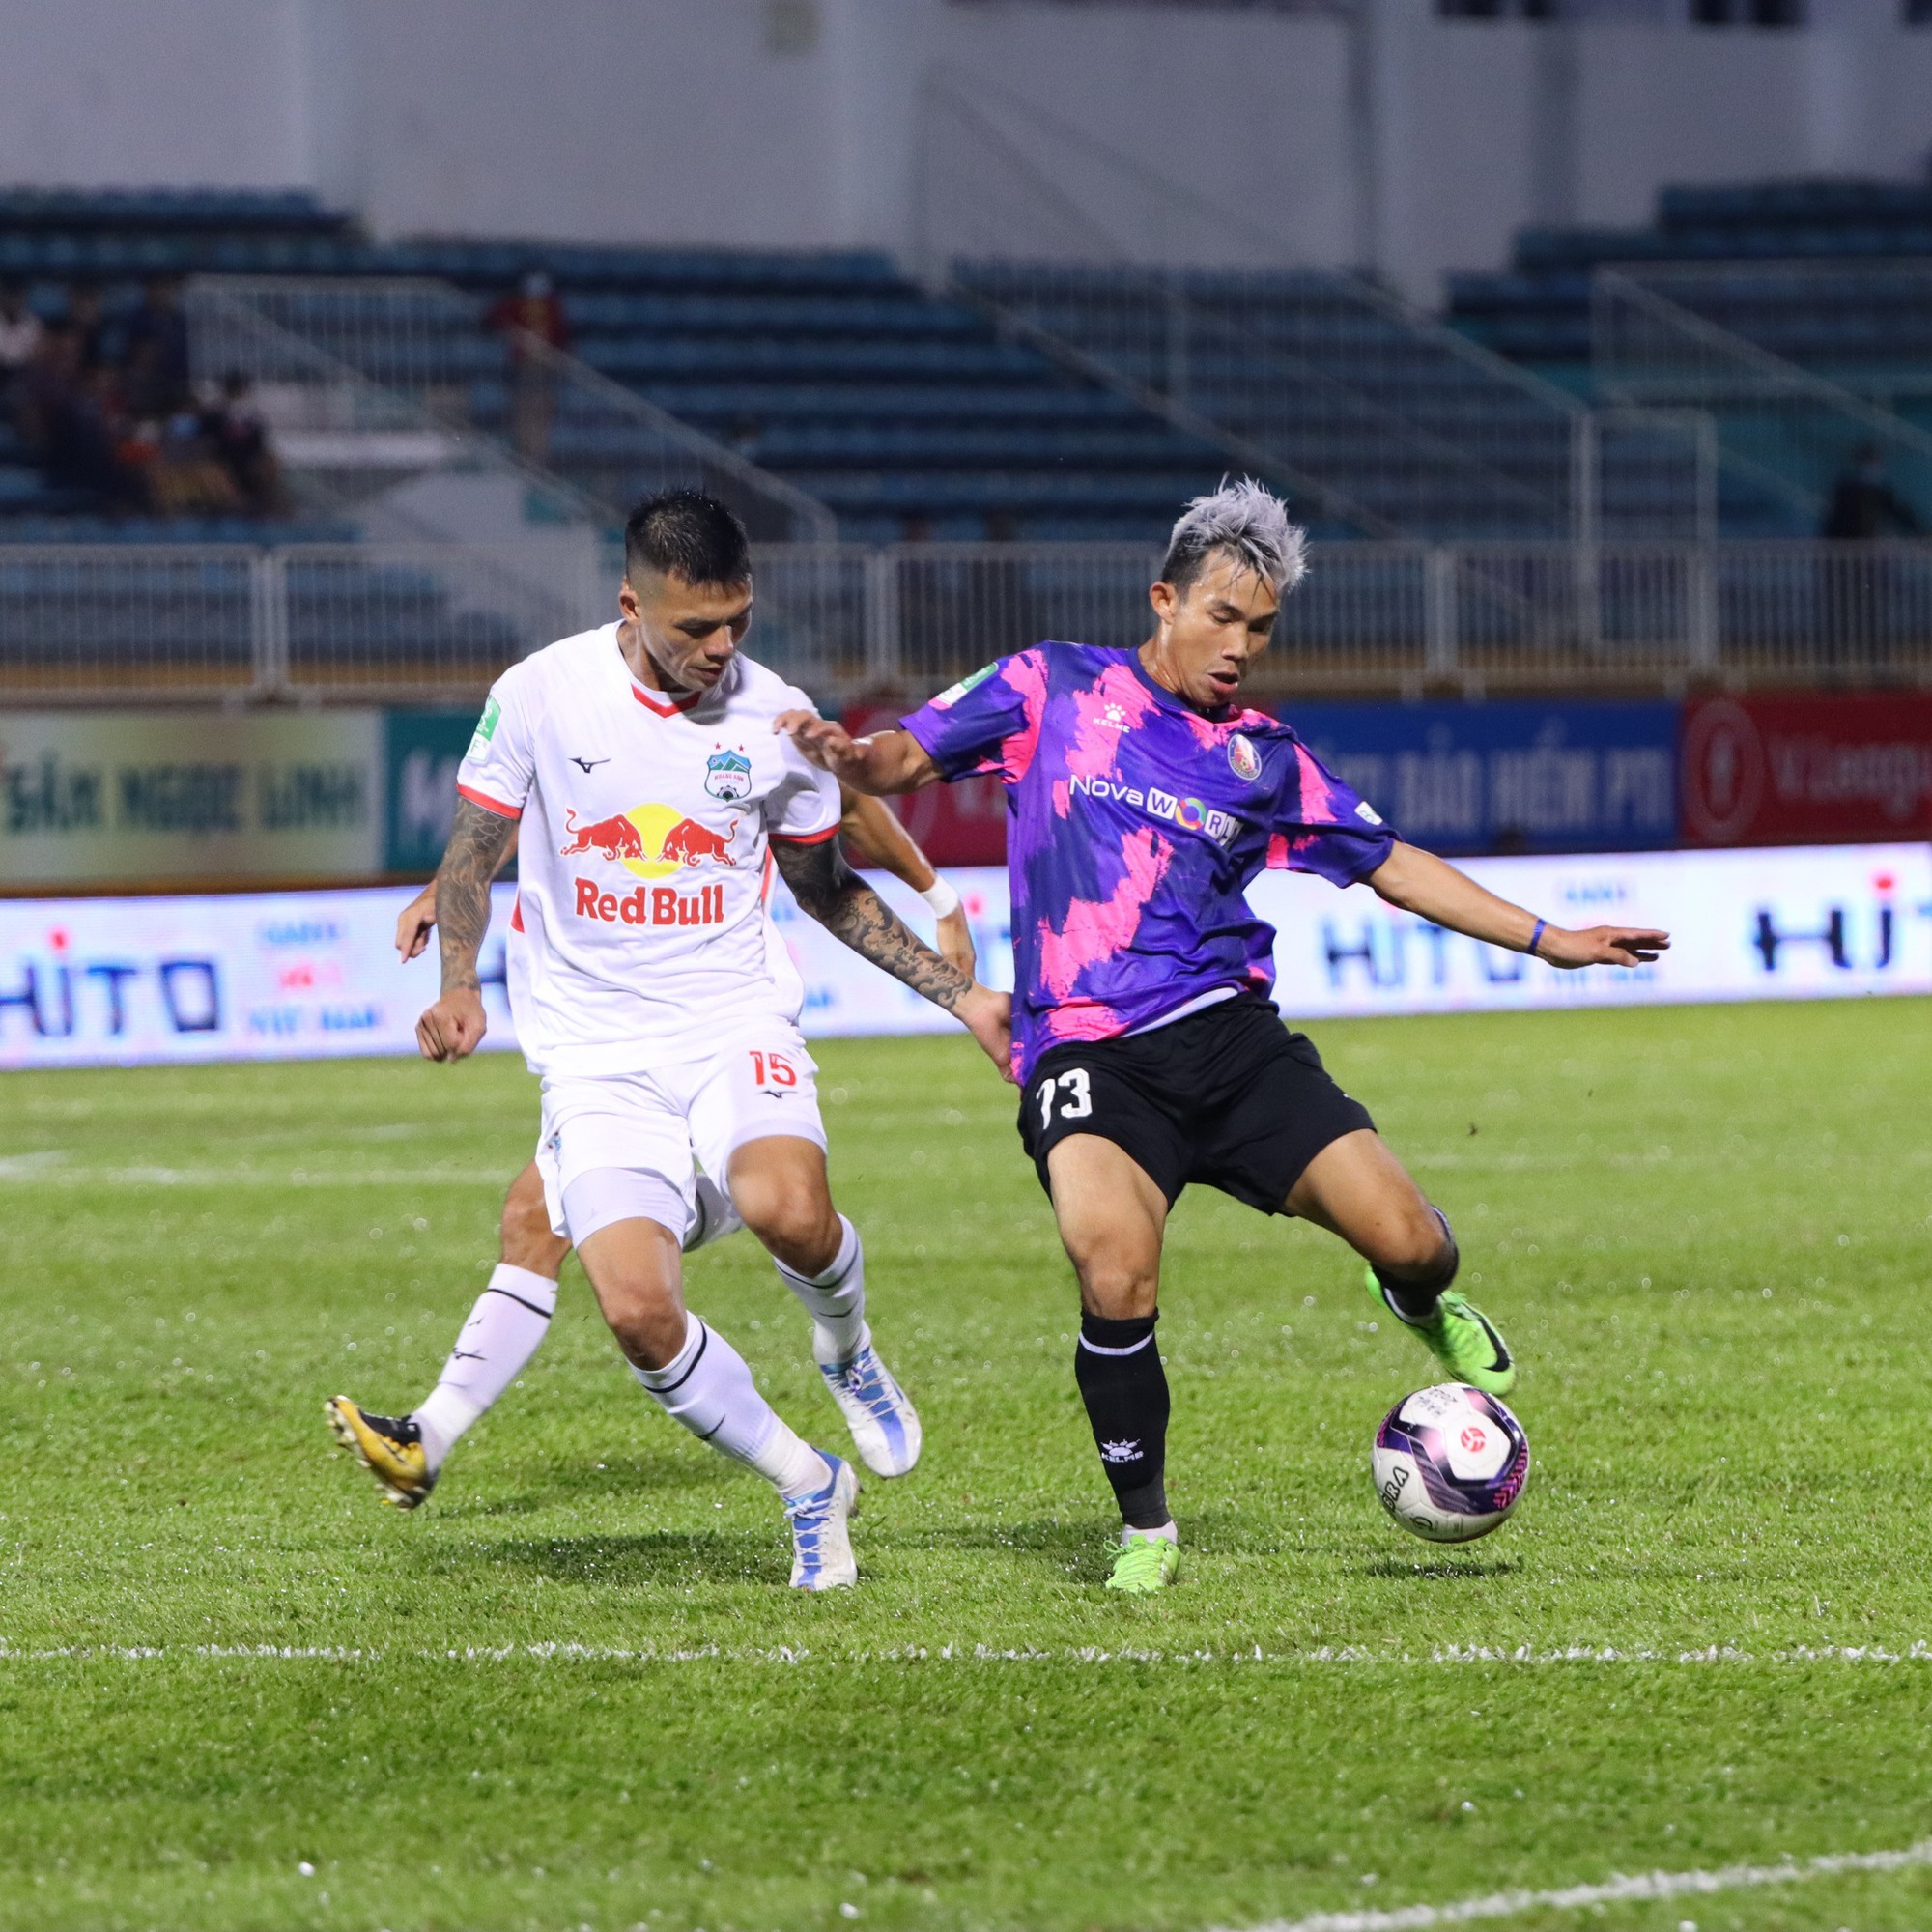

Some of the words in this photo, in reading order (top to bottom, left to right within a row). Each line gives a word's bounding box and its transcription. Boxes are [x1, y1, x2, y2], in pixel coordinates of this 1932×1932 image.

[1093, 717, 1131, 733] KELME
[575, 877, 647, 926] Red
[652, 883, 724, 926] Bull
[749, 1050, 797, 1087] 15
[1101, 1450, 1144, 1463] KELME
